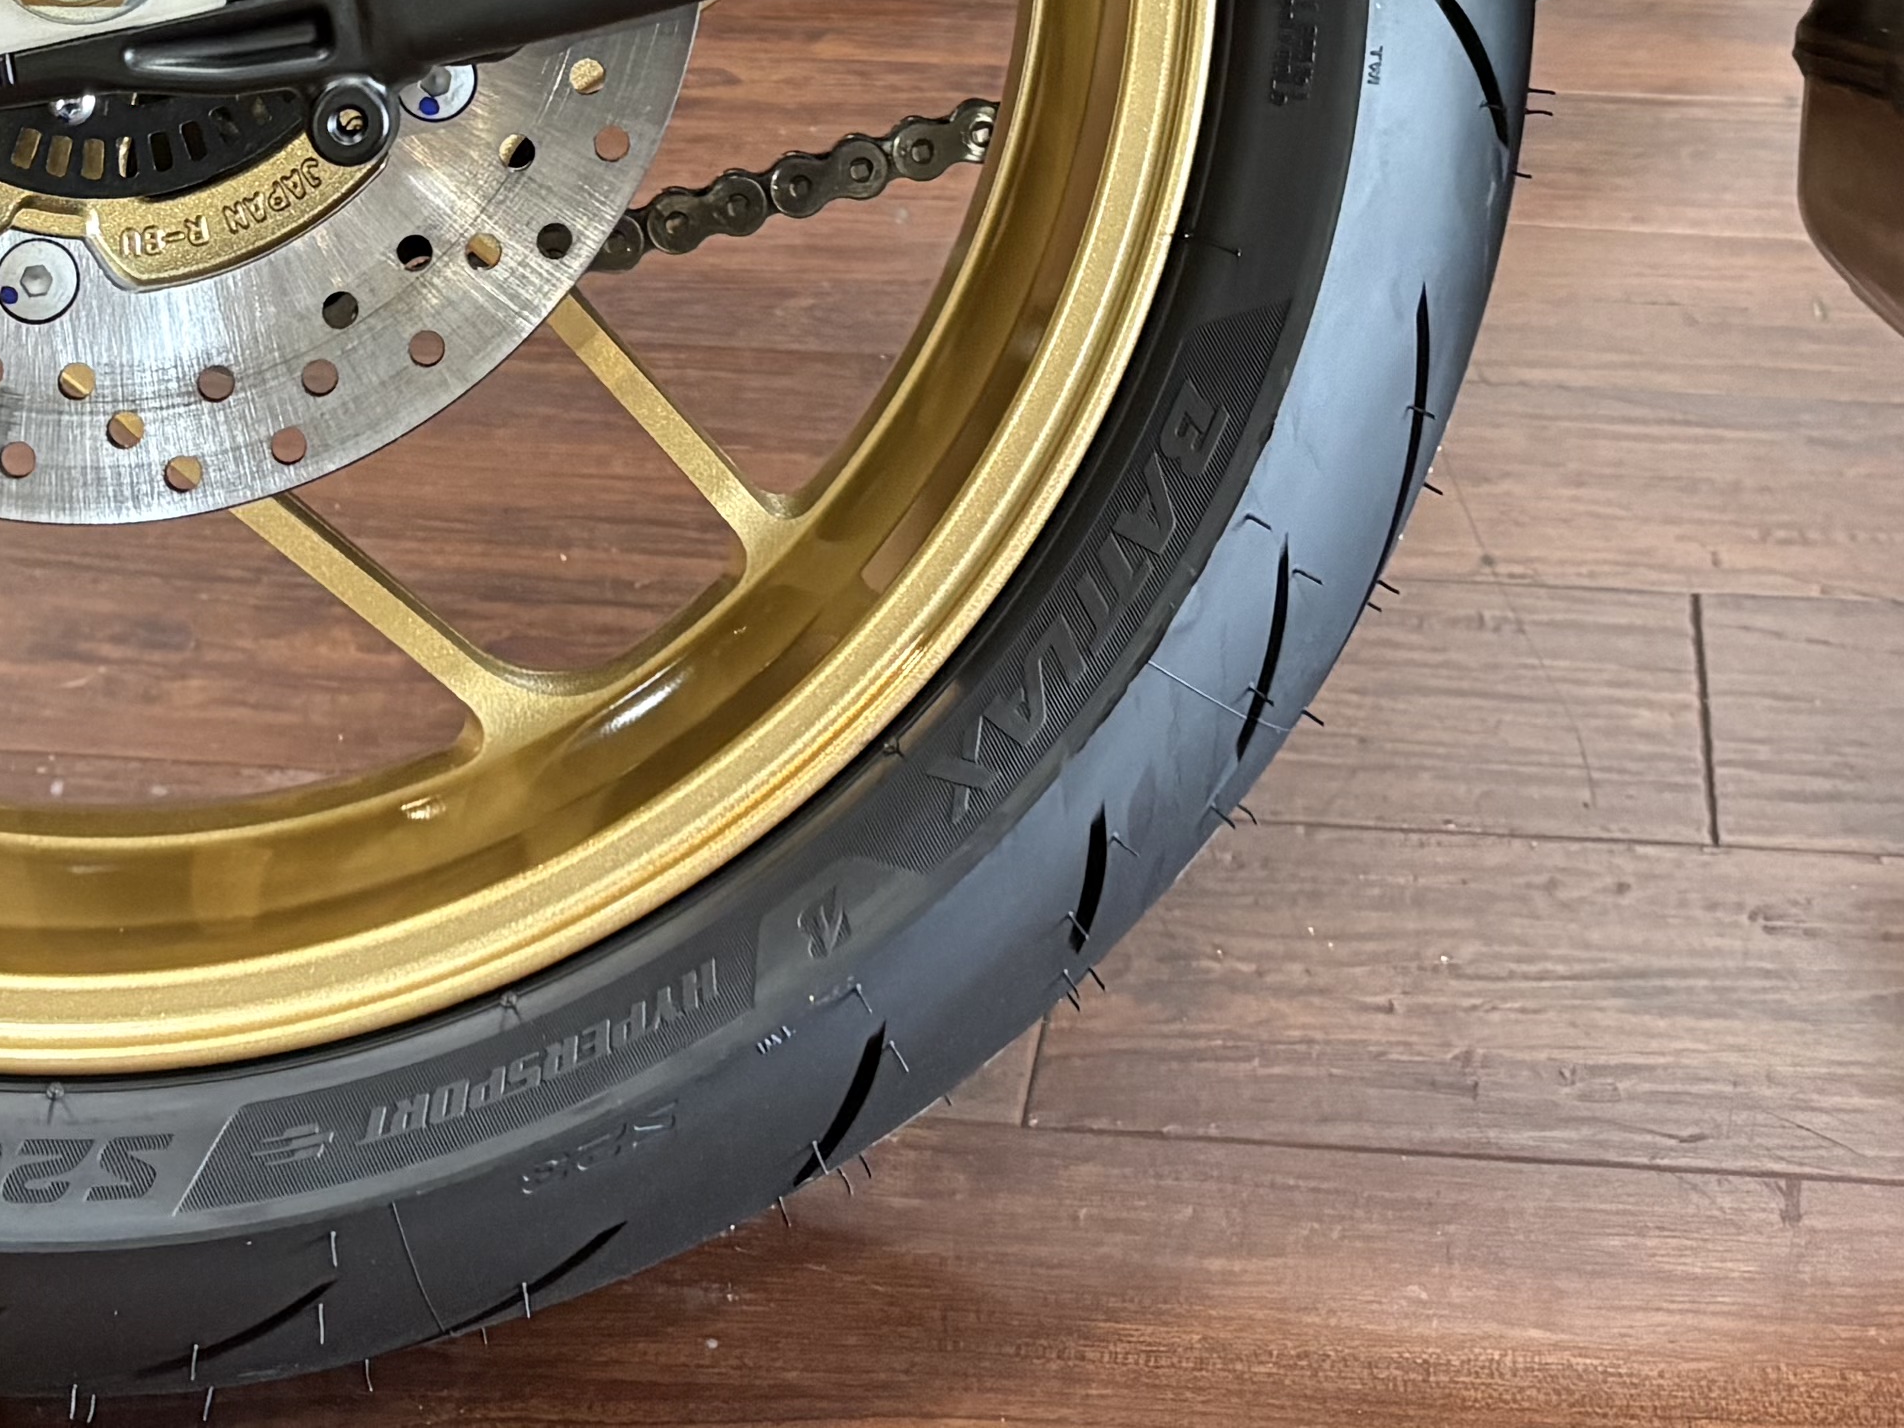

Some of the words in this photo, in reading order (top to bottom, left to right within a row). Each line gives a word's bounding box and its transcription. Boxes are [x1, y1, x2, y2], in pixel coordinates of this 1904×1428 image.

[220, 156, 323, 236] JAPAN
[925, 379, 1234, 826] BATTLAX
[362, 954, 722, 1145] HYPERSPORT
